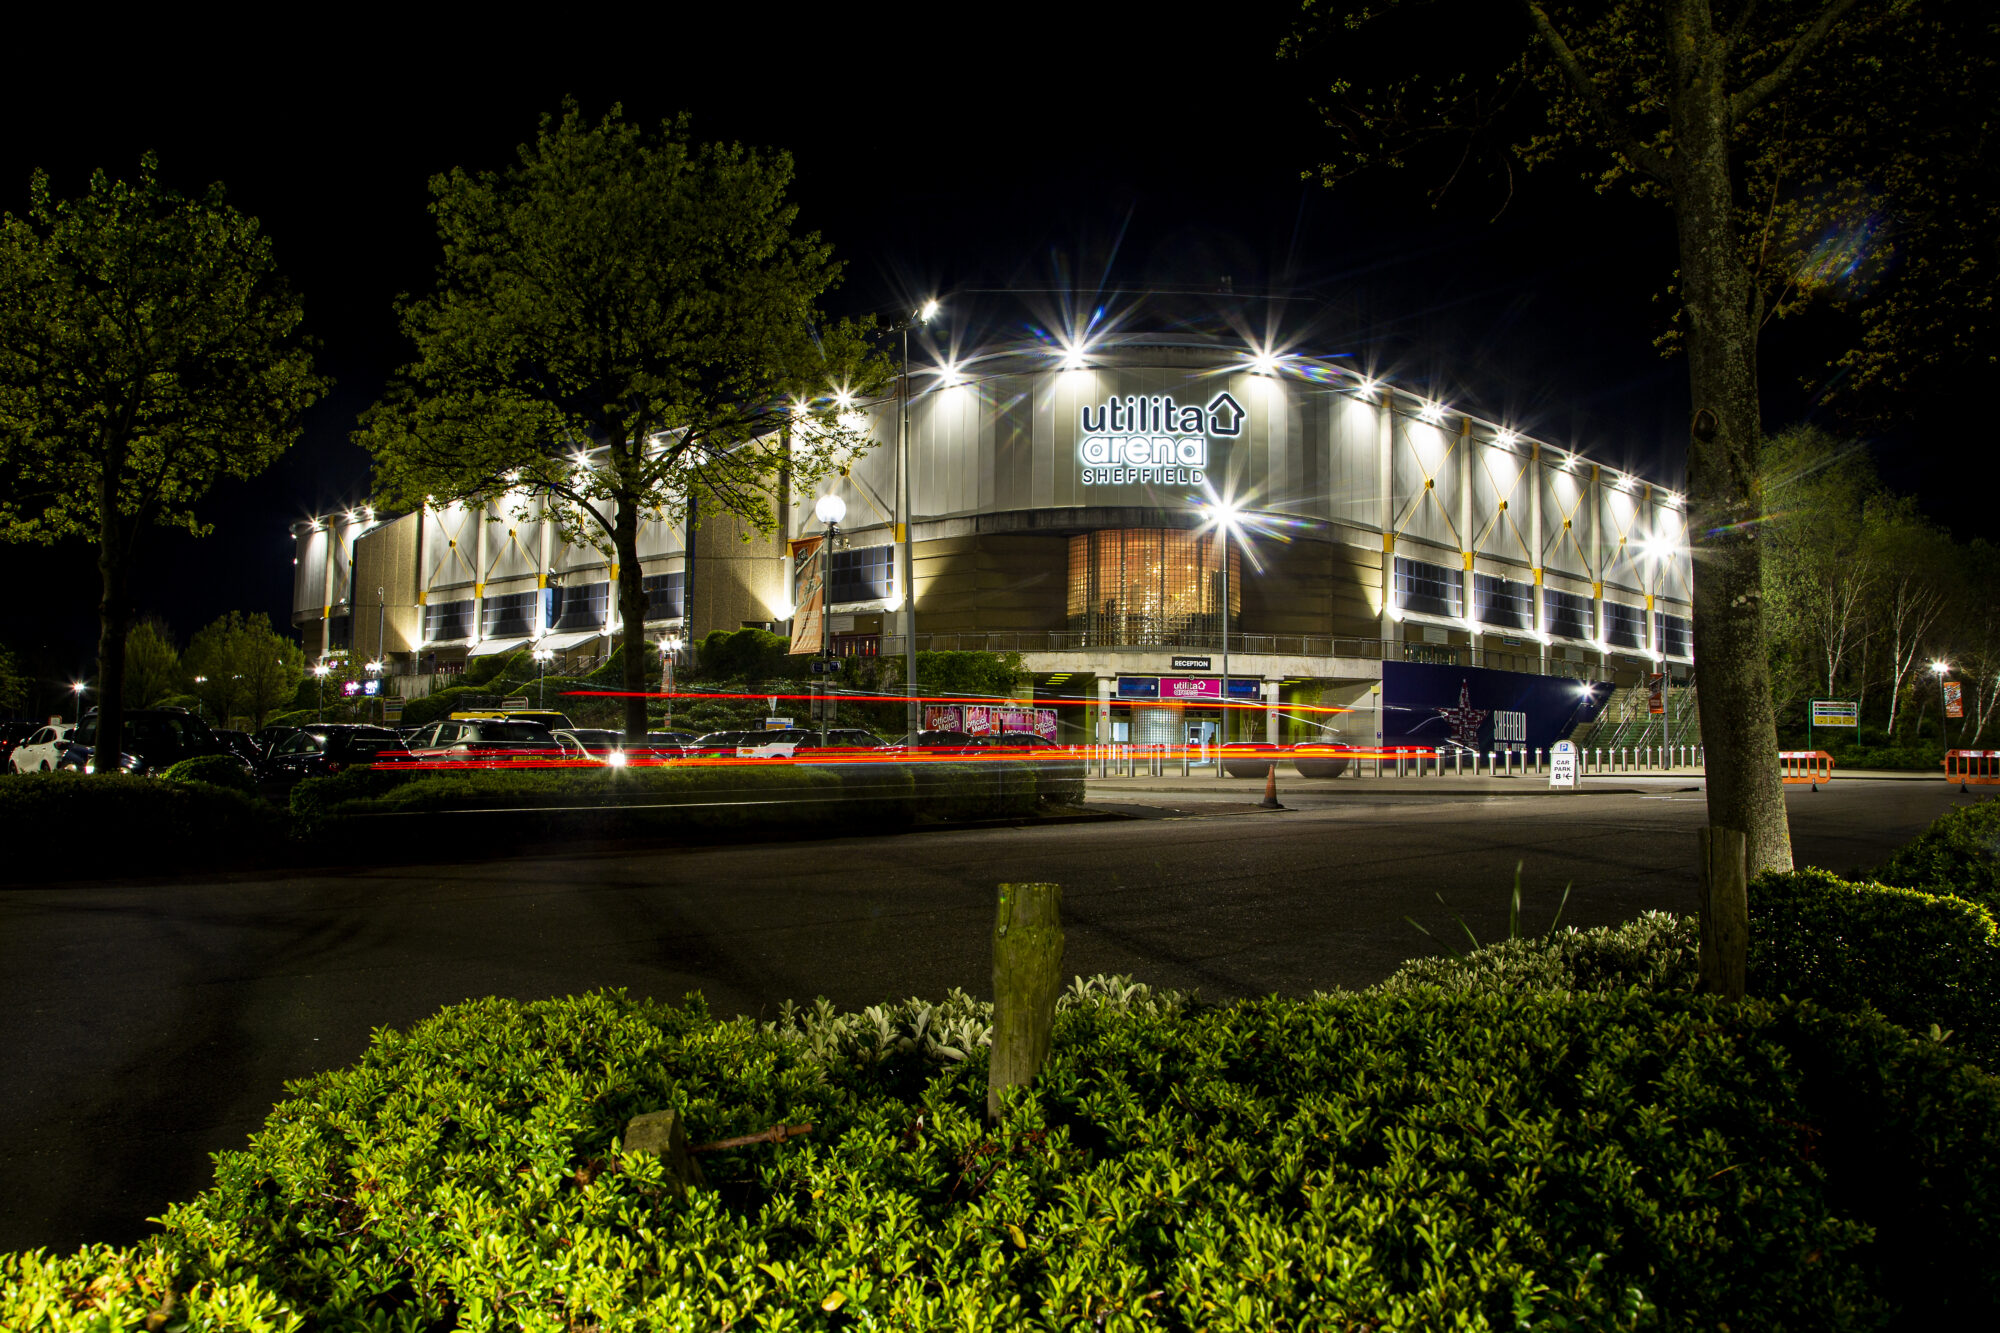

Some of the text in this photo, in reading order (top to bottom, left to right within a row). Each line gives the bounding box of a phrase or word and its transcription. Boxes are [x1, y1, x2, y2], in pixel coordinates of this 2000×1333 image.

[1082, 396, 1204, 433] utilita
[1081, 435, 1206, 466] arena
[1082, 469, 1204, 483] SHEFFIELD
[1173, 682, 1198, 690] utilita
[932, 711, 955, 727] Official
[938, 719, 960, 731] Merch
[966, 716, 986, 728] Official
[1494, 710, 1526, 741] SHEFFIELD
[972, 722, 990, 733] Merch
